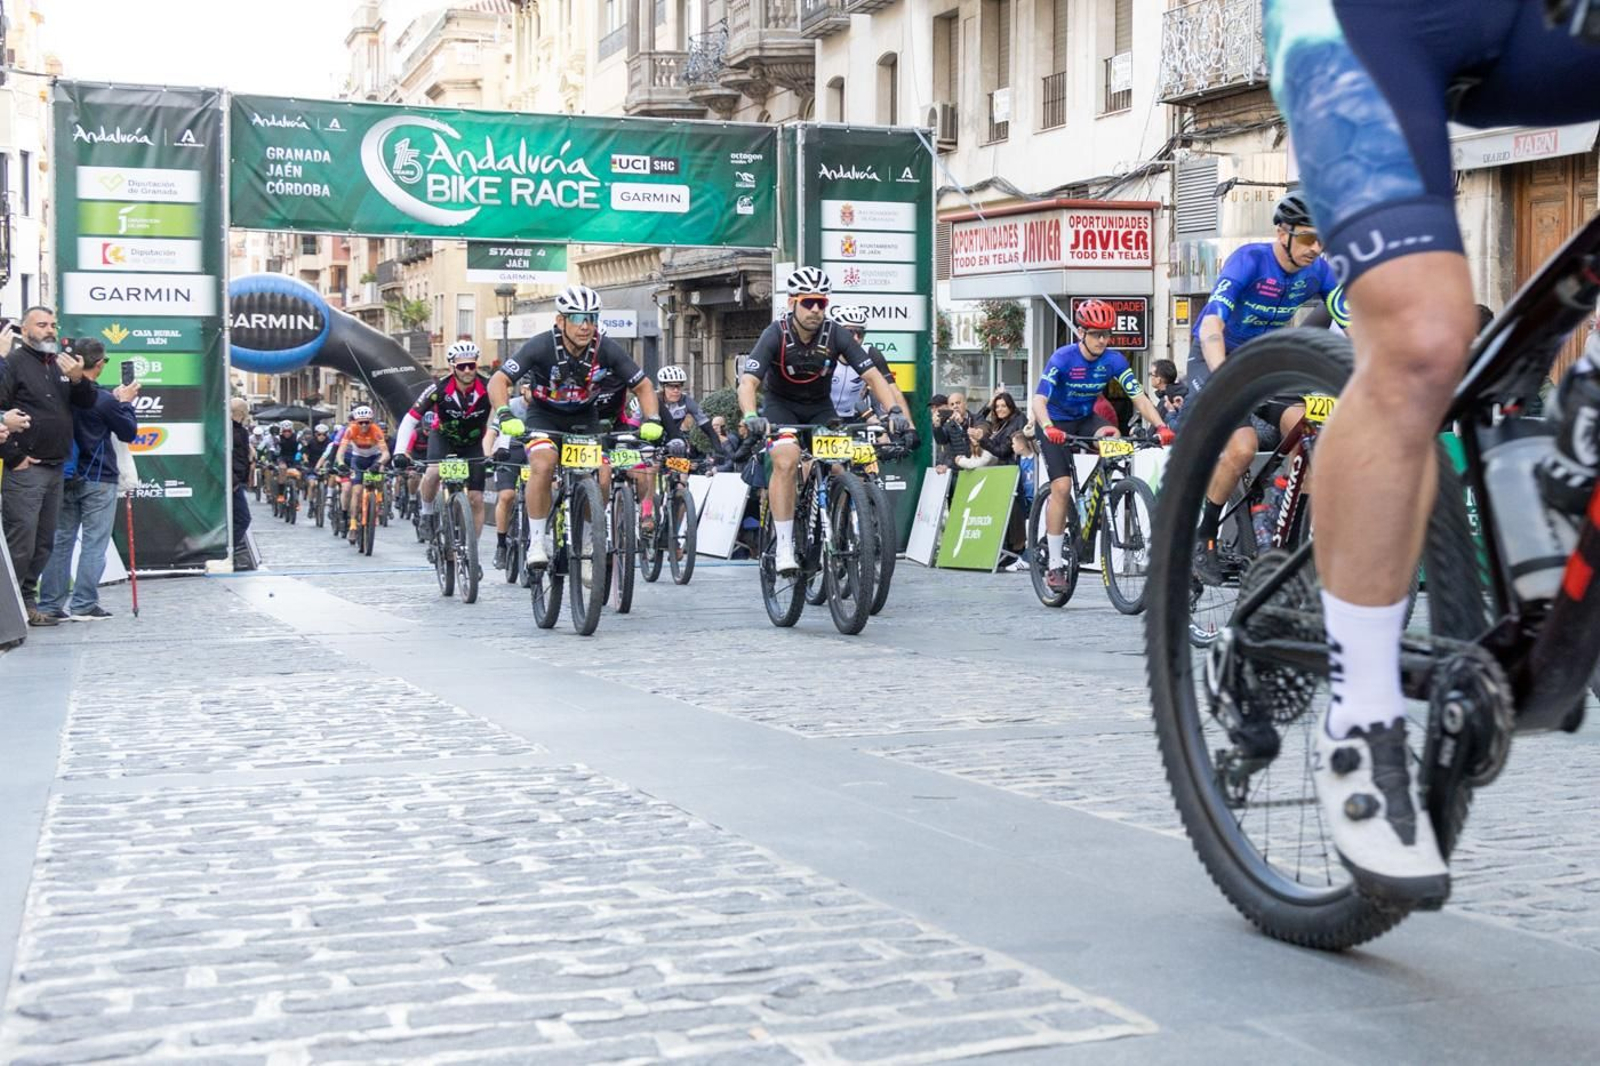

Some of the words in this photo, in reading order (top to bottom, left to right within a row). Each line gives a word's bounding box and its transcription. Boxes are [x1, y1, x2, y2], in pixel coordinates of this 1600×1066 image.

[250, 113, 311, 130] Andalucía
[73, 124, 155, 146] Andalucía
[266, 146, 331, 163] GRANADA
[425, 133, 599, 180] Andalucía
[266, 162, 302, 179] JAÉN
[618, 158, 647, 171] UCI
[654, 160, 675, 172] SHC
[818, 164, 882, 182] Andalucía
[128, 179, 175, 190] Diputación
[266, 179, 330, 197] CÓRDOBA
[427, 174, 501, 205] BIKE
[511, 178, 600, 209] RACE
[141, 188, 178, 196] Granada
[620, 191, 682, 204] GARMIN
[1069, 215, 1148, 230] OPORTUNIDADES
[953, 223, 1019, 254] OPORTUNIDADES
[1022, 219, 1061, 263] JAVIER
[1070, 230, 1148, 251] JAVIER
[131, 248, 176, 257] Diputación
[488, 248, 531, 257] STAGE
[537, 249, 546, 257] 4
[1070, 251, 1098, 260] TODO
[1102, 251, 1114, 260] EN
[1118, 251, 1149, 260] TELAS
[506, 257, 529, 268] JAÉN
[954, 255, 976, 268] TODO
[978, 254, 990, 267] EN
[992, 254, 1019, 265] TELAS
[499, 273, 536, 281] GARMIN
[89, 286, 191, 302] GARMIN
[830, 305, 908, 319] GRMIN
[230, 313, 315, 330] ARMIN
[157, 329, 181, 338] RURAL
[1118, 336, 1142, 346] TELAS
[371, 365, 415, 378] garmin.com
[816, 439, 851, 455] 216-2
[565, 446, 598, 463] 216-1
[441, 463, 467, 475] 319-2
